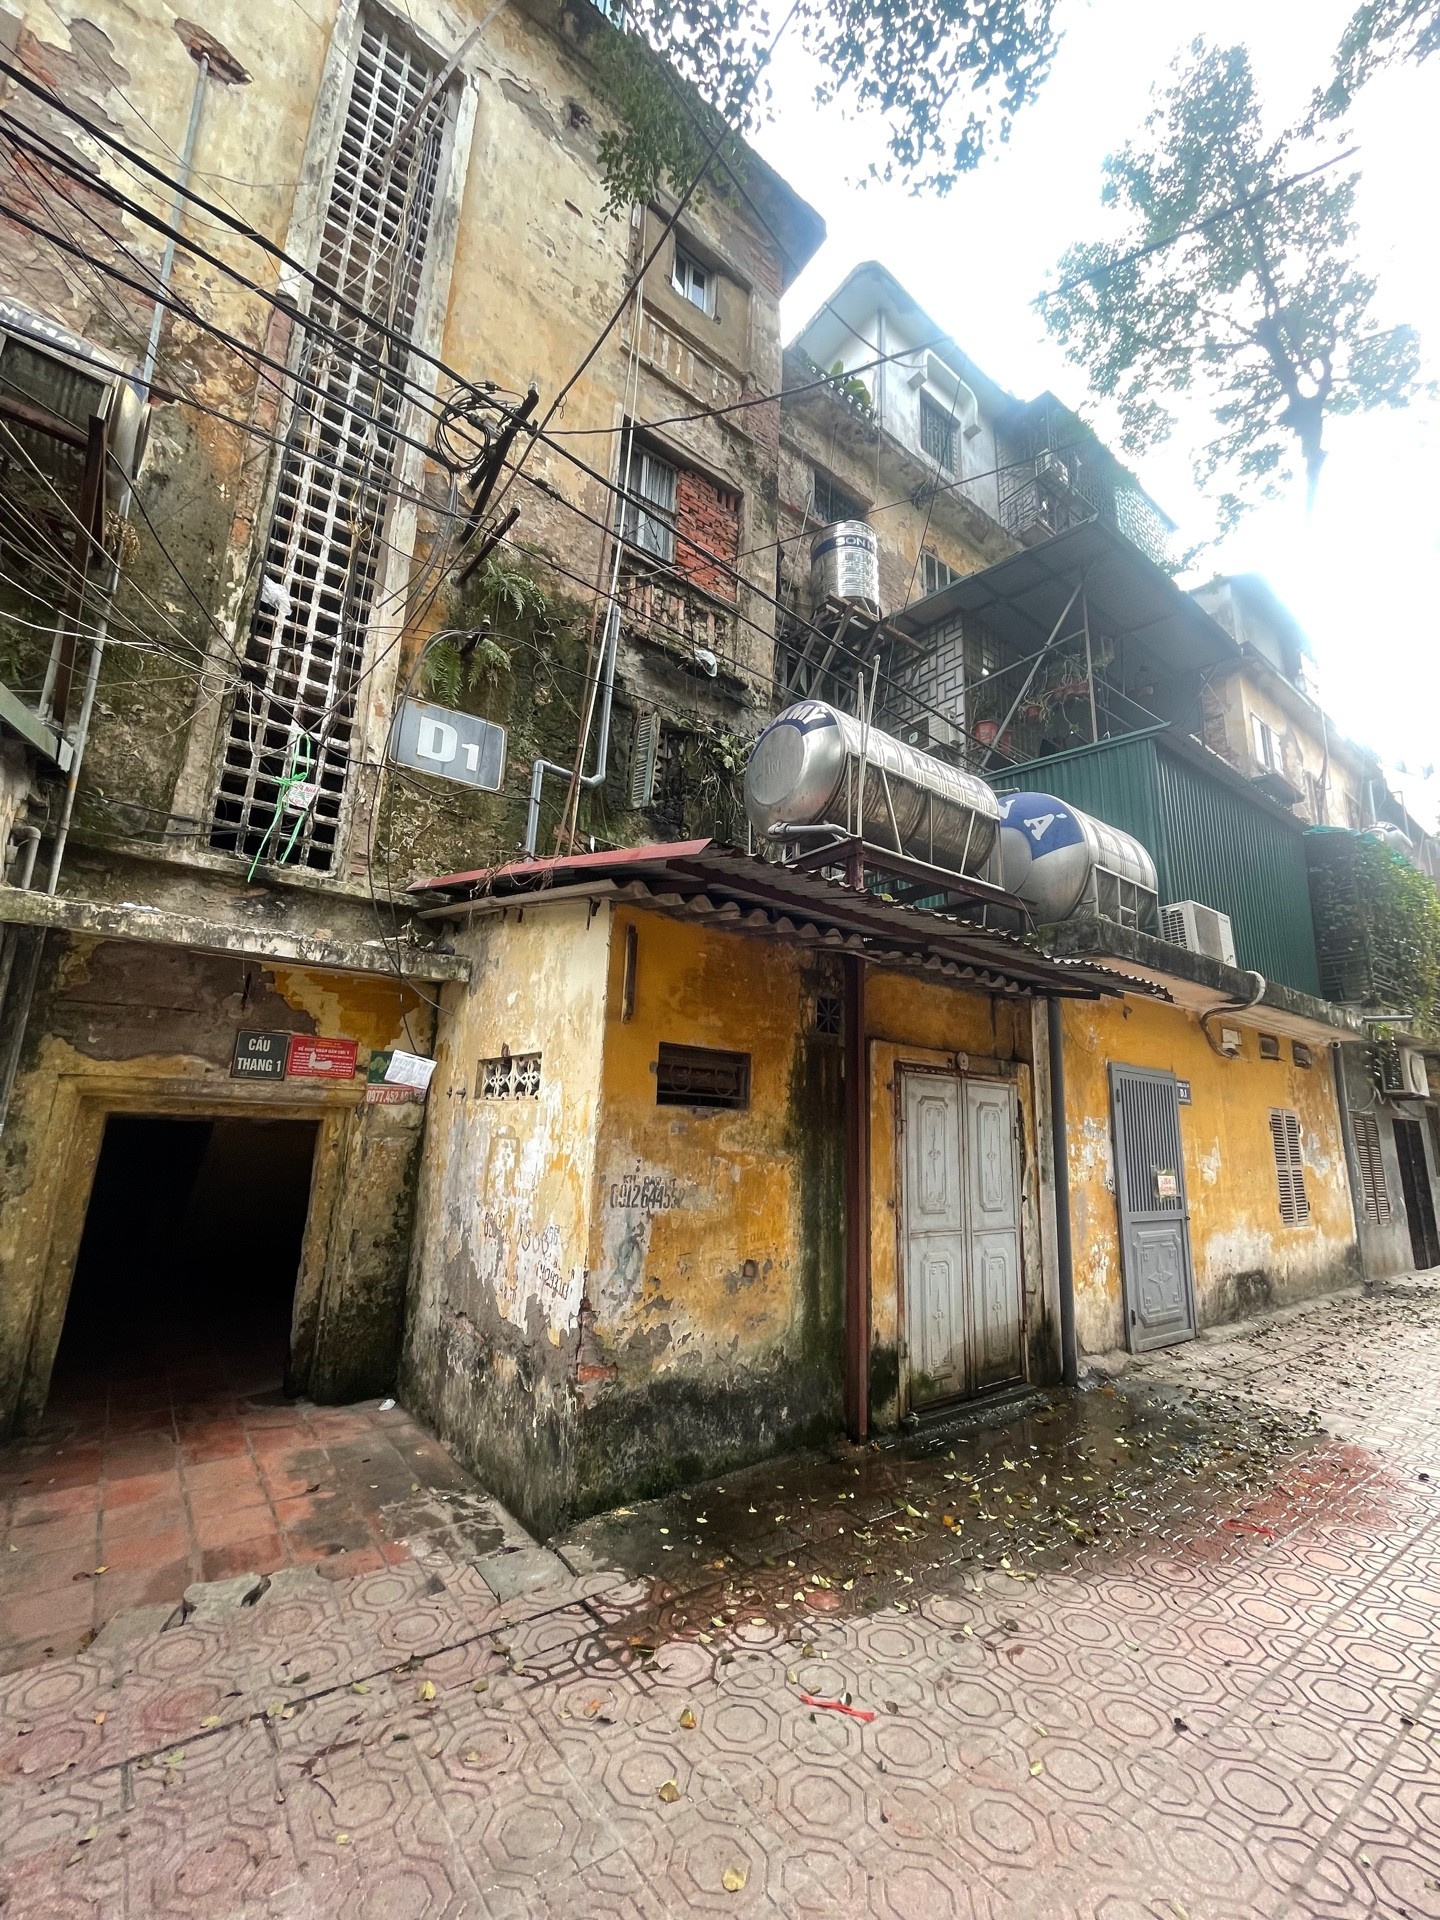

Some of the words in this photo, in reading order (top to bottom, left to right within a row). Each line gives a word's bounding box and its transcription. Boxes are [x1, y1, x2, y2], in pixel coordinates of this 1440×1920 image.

[417, 716, 479, 772] D1
[237, 1057, 273, 1072] THANG
[276, 1060, 281, 1072] 1
